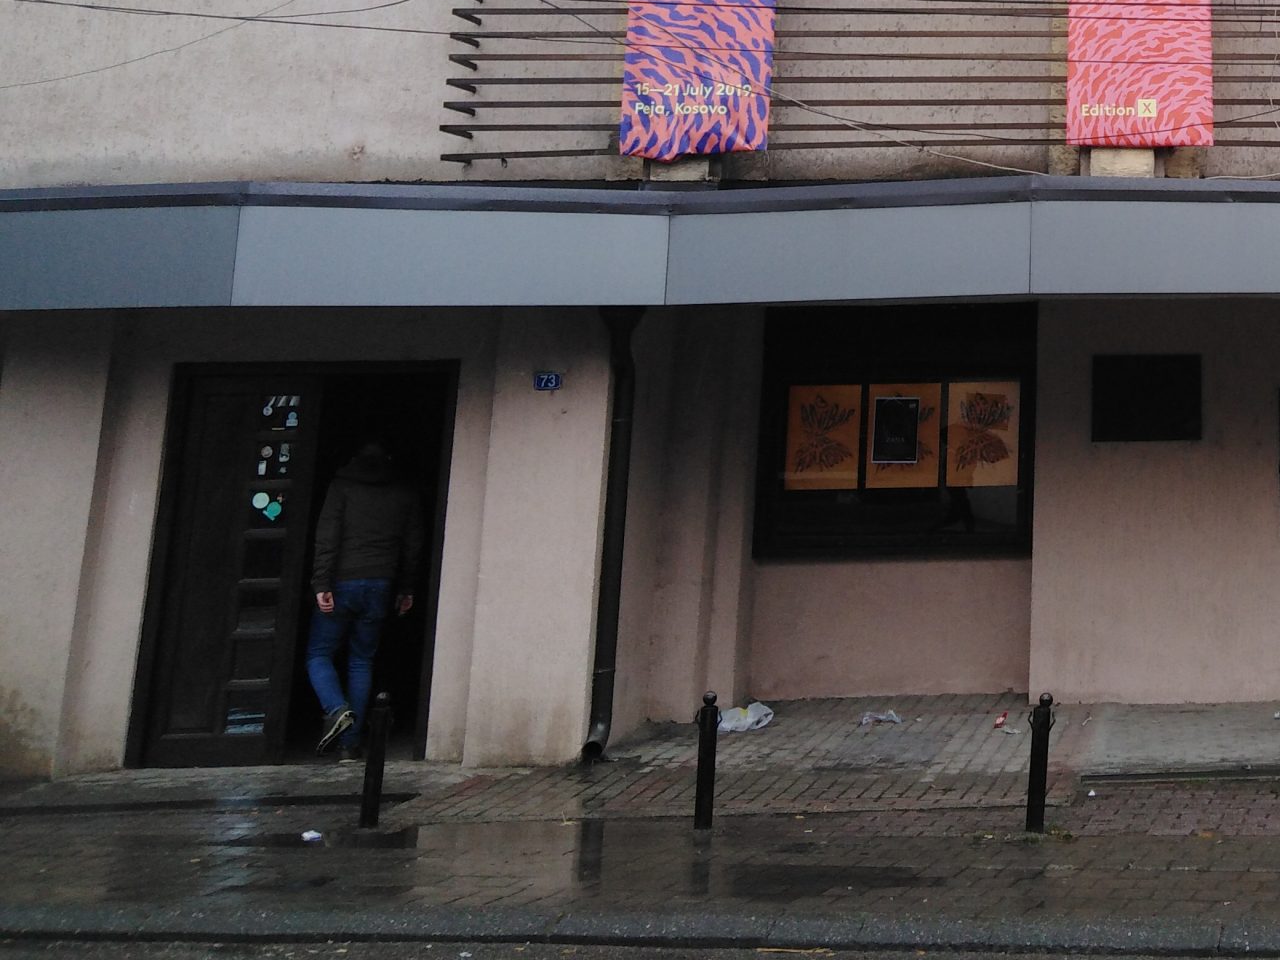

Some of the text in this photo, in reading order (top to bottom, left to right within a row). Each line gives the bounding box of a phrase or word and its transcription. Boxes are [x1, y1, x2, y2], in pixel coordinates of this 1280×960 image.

[682, 83, 714, 99] July
[634, 100, 728, 117] Peja, Kosovo
[1081, 103, 1136, 117] Edition
[540, 375, 556, 387] 73
